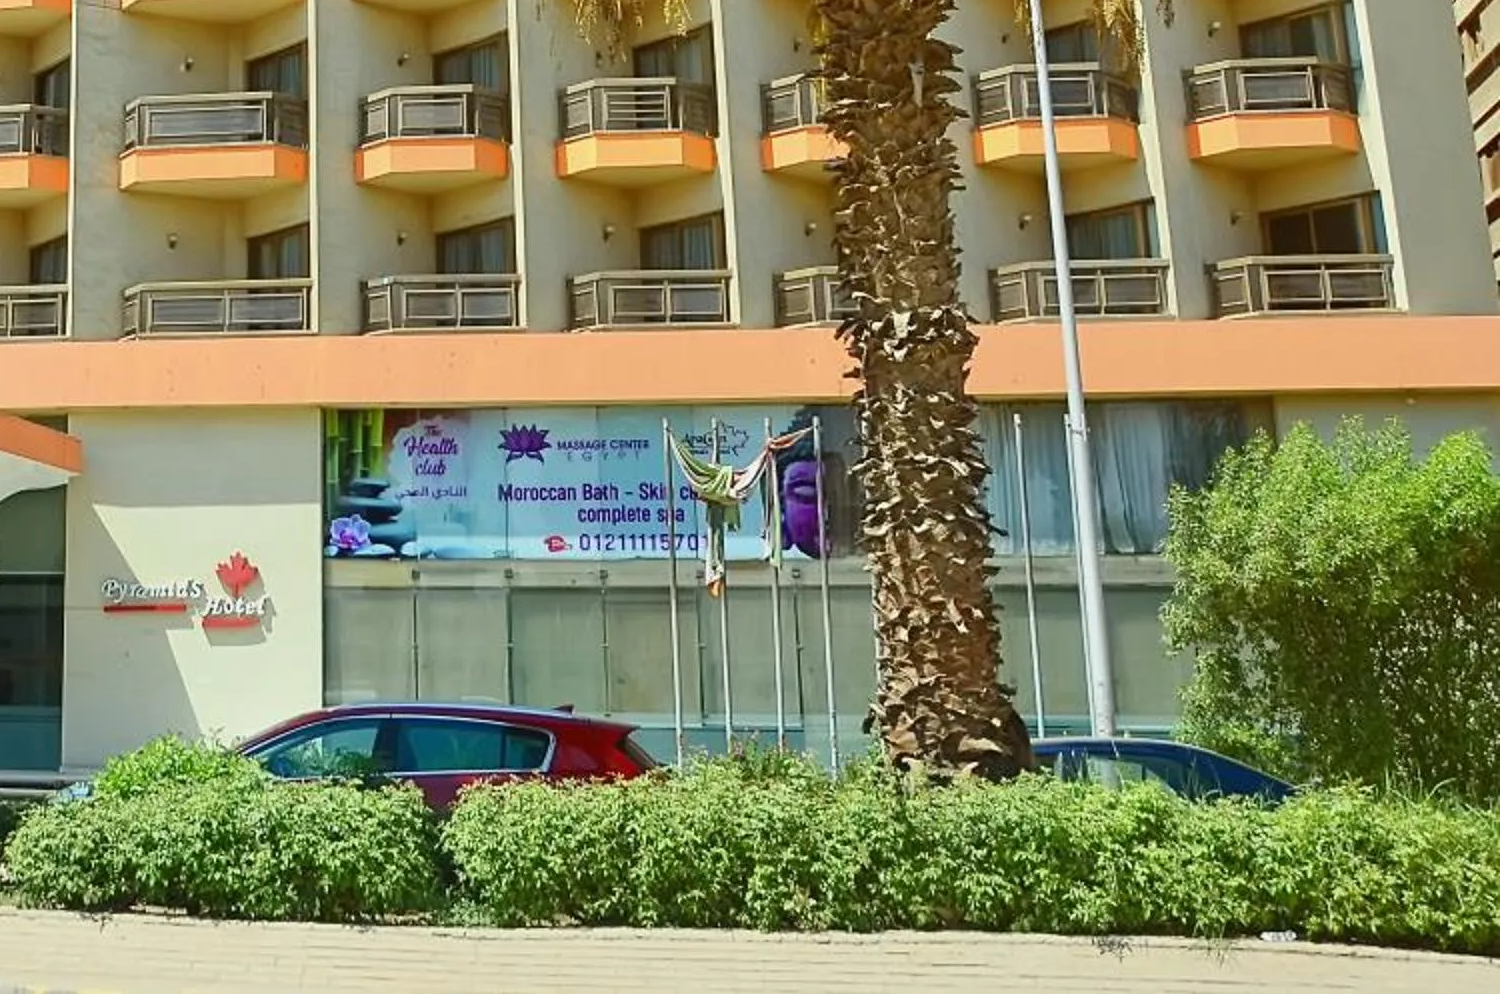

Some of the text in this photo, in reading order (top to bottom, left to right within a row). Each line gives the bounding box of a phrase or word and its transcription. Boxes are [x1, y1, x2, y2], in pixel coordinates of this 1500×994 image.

[403, 435, 458, 456] Health
[557, 439, 649, 451] MASSAGE CENTER
[415, 458, 446, 476] club
[497, 483, 576, 501] Moroccan
[582, 483, 619, 501] Bath
[577, 506, 651, 526] complete
[202, 594, 269, 617] Hotel
